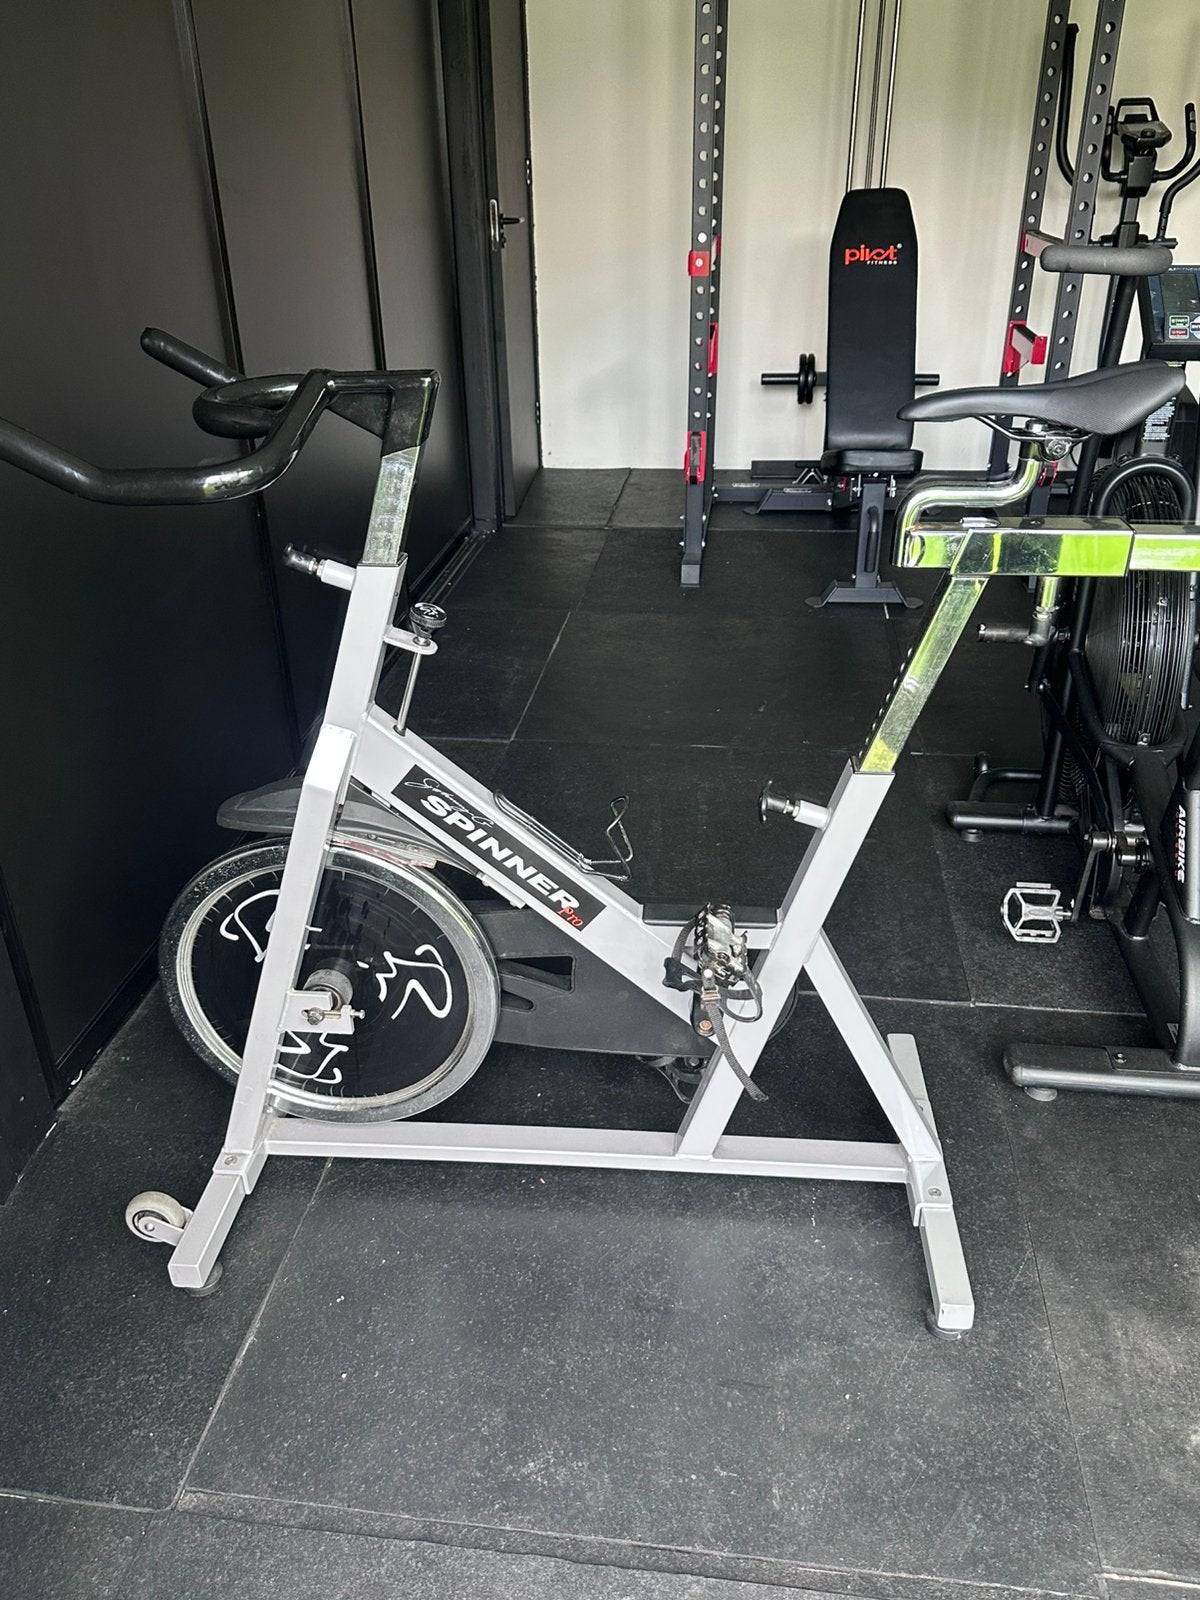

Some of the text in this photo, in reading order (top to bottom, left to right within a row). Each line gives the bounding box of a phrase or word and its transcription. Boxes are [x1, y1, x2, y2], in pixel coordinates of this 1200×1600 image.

[844, 244, 898, 265] pivot
[420, 795, 580, 909] SPINNER
[1177, 804, 1187, 884] AIRBIKE
[556, 905, 584, 928] Pro
